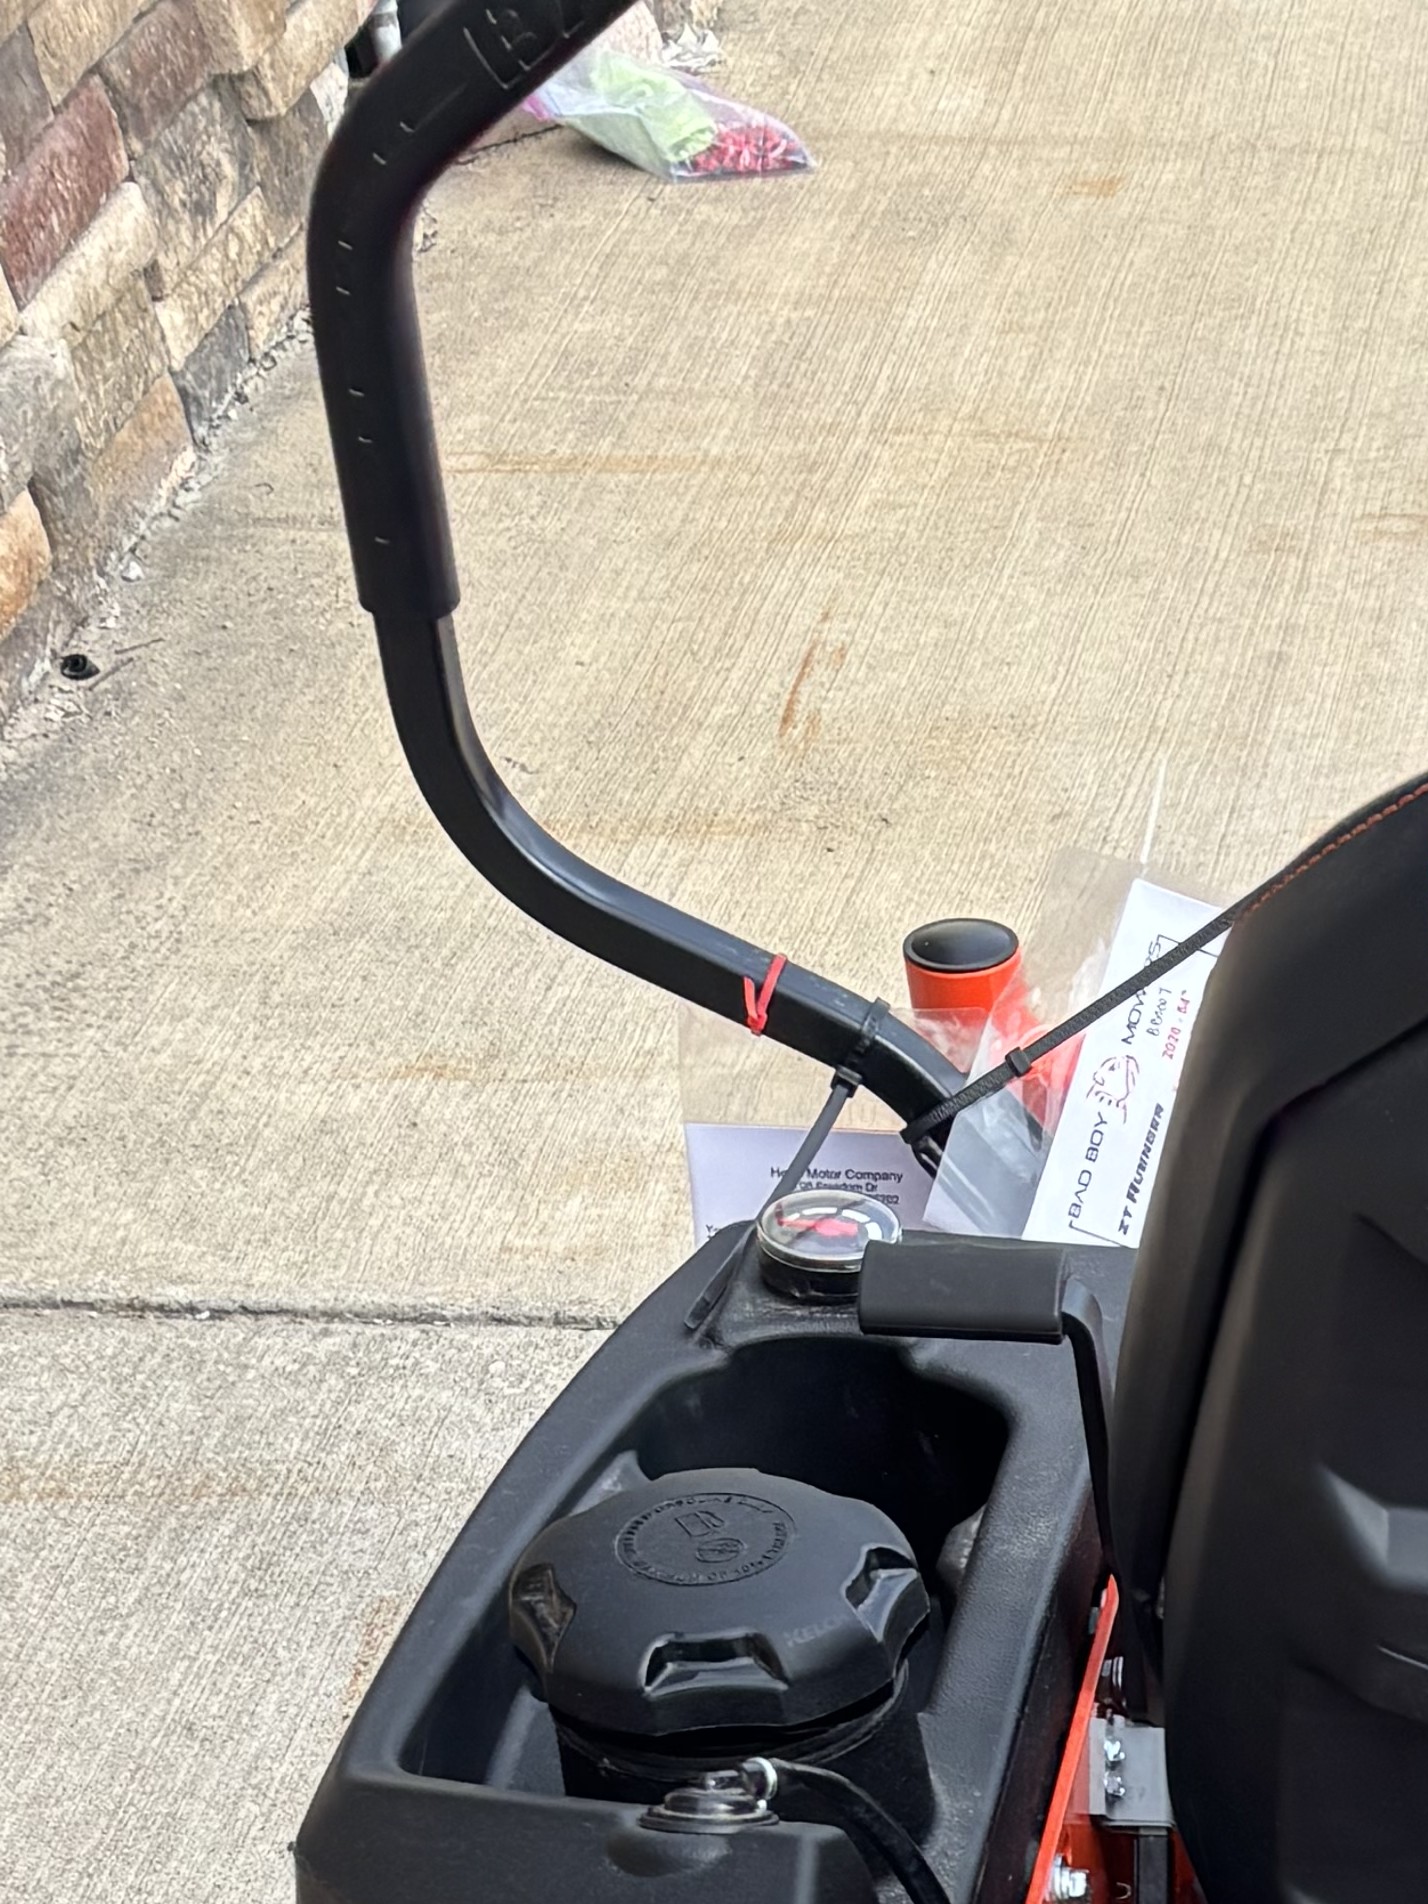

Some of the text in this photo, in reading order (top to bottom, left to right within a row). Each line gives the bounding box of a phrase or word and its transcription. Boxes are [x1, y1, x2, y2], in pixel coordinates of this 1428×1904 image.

[1069, 1169, 1092, 1220] BAD
[1085, 1112, 1108, 1162] BOY
[1121, 940, 1161, 1045] MOWS
[807, 1167, 841, 1180] Motor
[845, 1169, 903, 1183] Company
